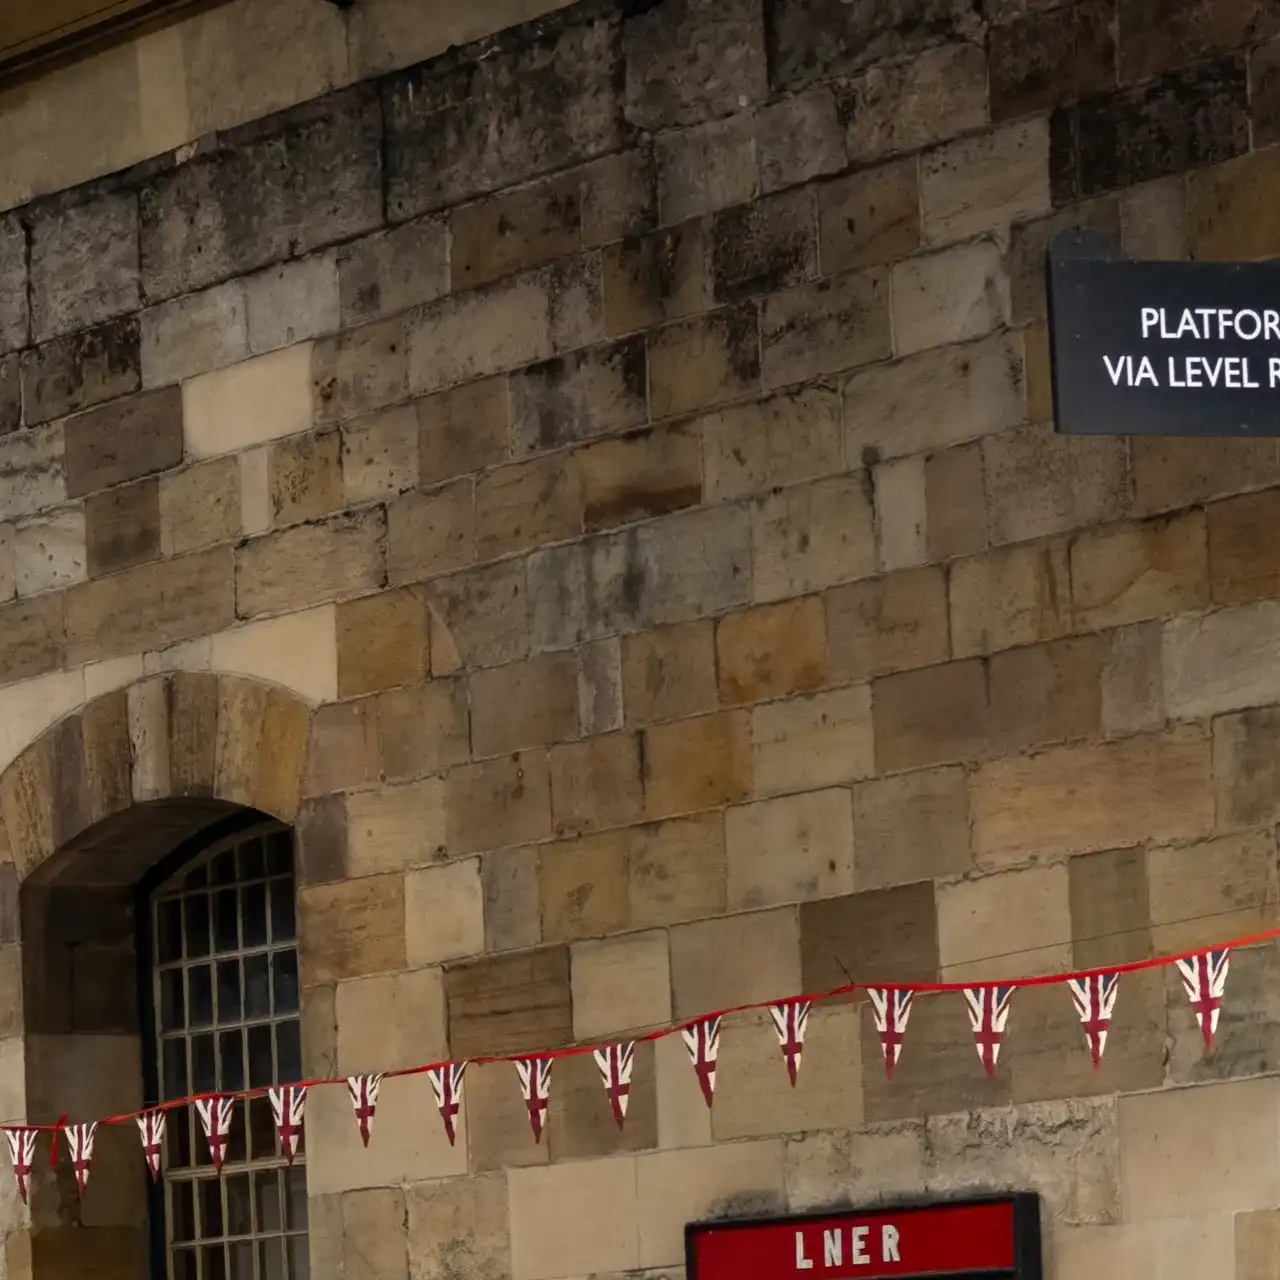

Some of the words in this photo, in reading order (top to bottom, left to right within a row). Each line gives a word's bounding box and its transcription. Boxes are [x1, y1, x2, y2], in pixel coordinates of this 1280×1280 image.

[1102, 354, 1159, 387] VIA
[1168, 356, 1260, 388] LEVEL
[795, 1224, 901, 1271] LNER
